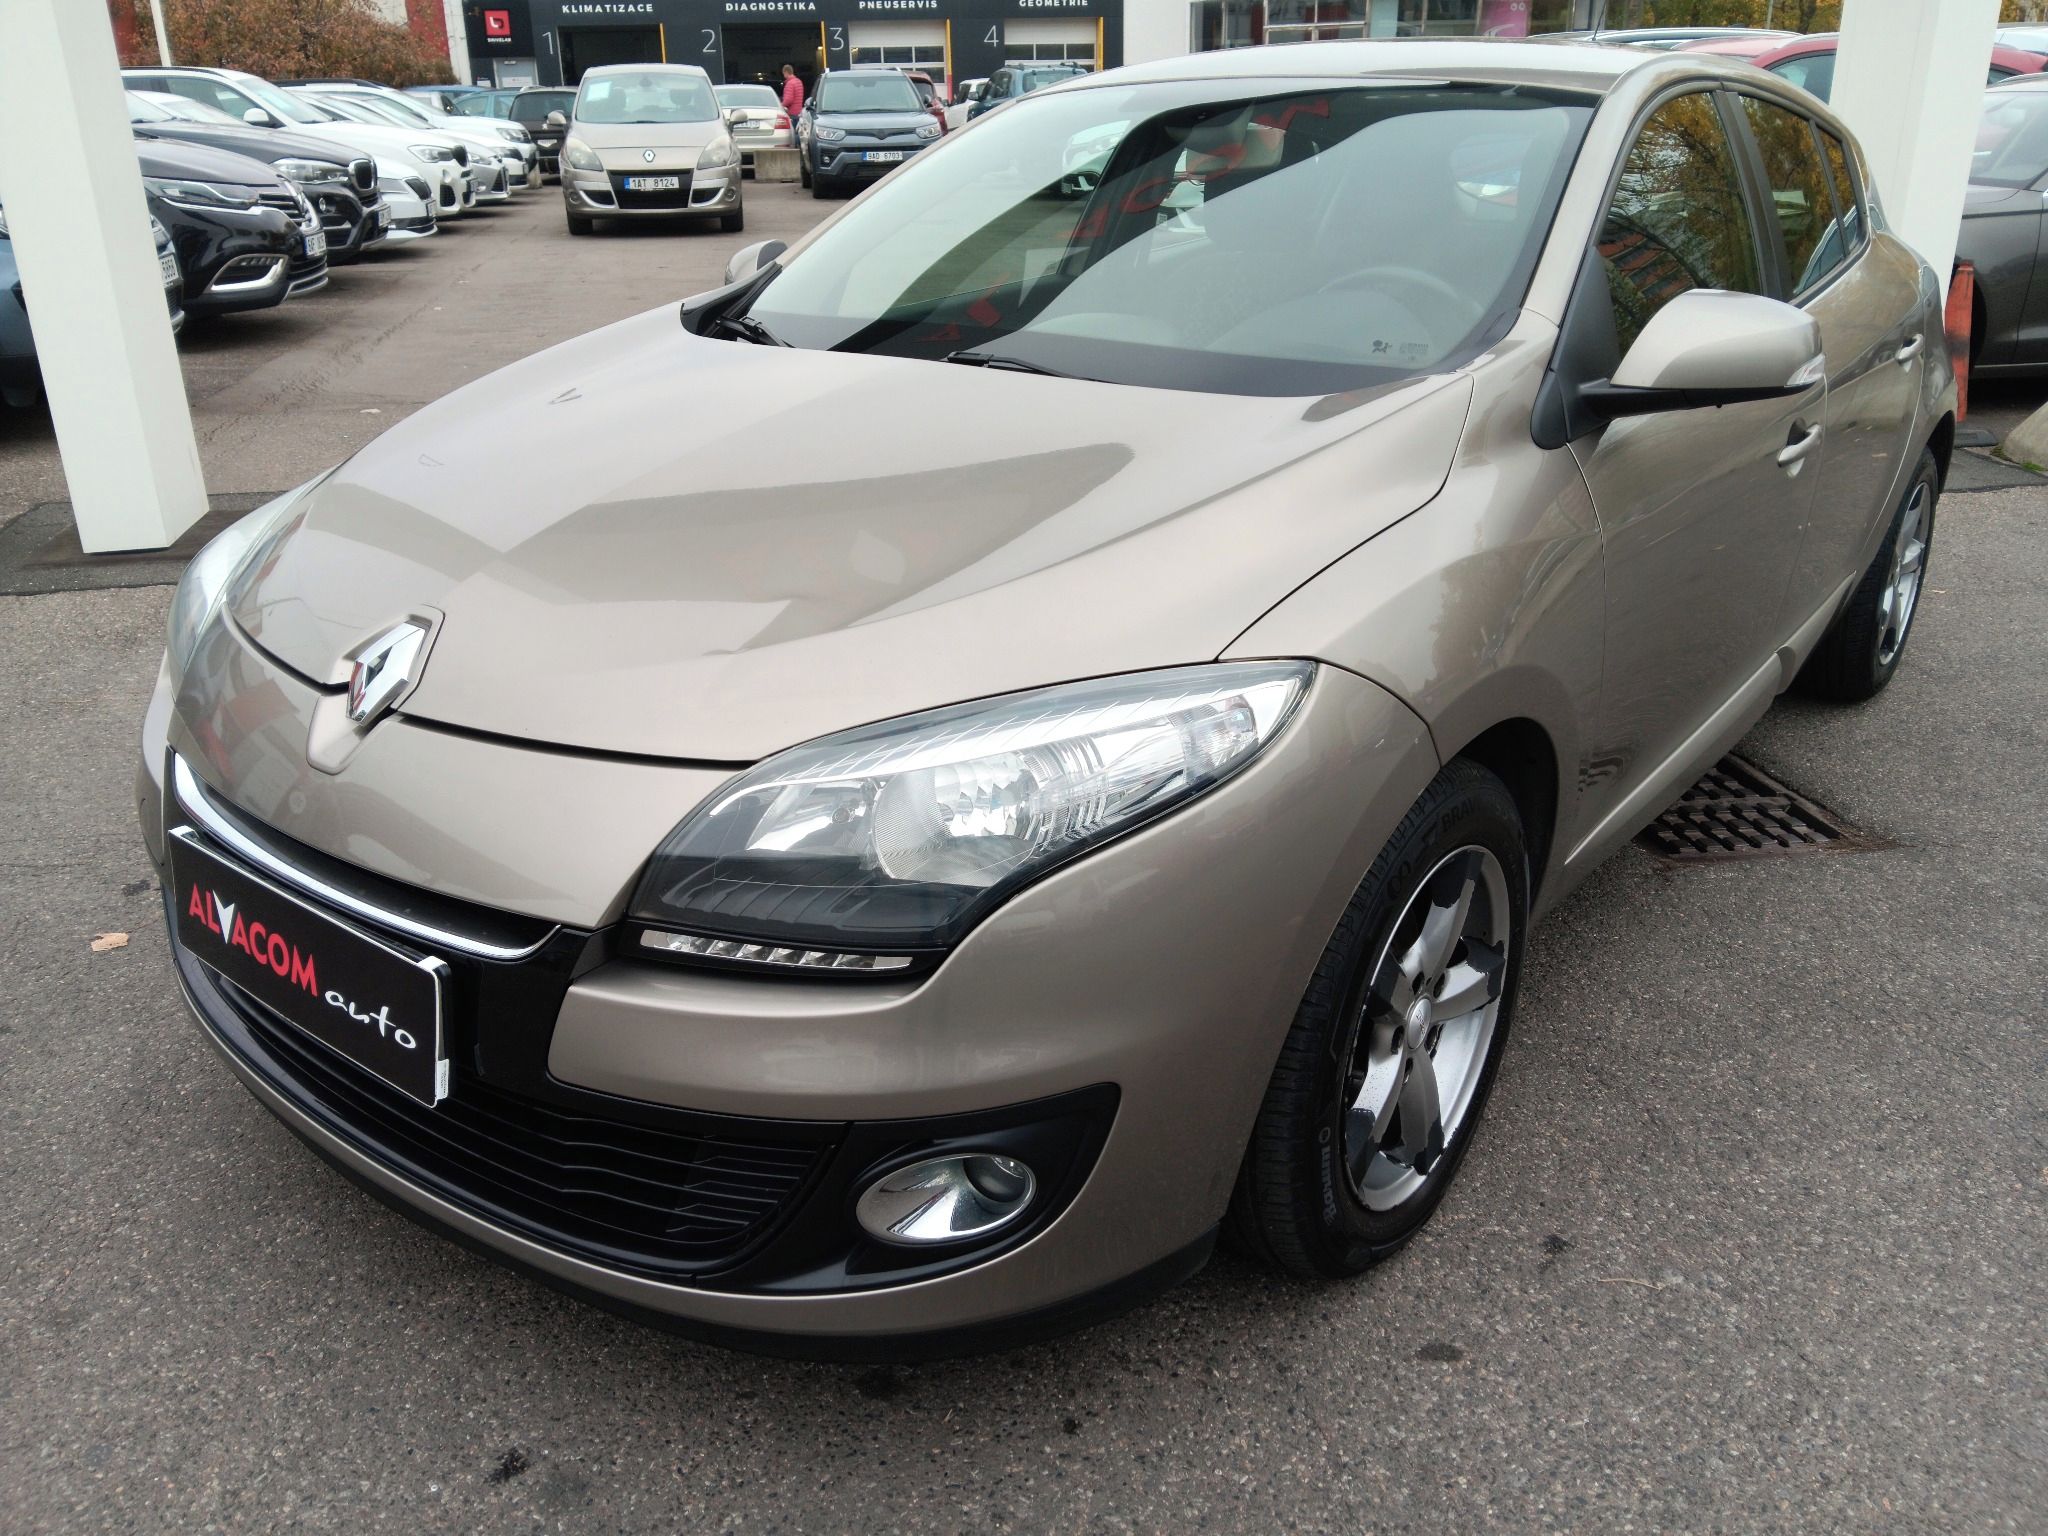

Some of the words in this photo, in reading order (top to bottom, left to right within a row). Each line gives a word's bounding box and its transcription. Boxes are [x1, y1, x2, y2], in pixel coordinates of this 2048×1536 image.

[562, 4, 653, 13] KLIMATIZACE
[726, 2, 816, 11] DIAGNOSTIKA
[859, 0, 938, 9] PNEUSERVIS
[542, 32, 554, 54] 1
[701, 29, 717, 52] 2
[829, 27, 844, 51] 3
[983, 25, 999, 48] 4
[632, 178, 646, 188] 1AT
[653, 178, 675, 188] 8124
[189, 882, 318, 997] ALVACOM
[324, 990, 417, 1049] auto
